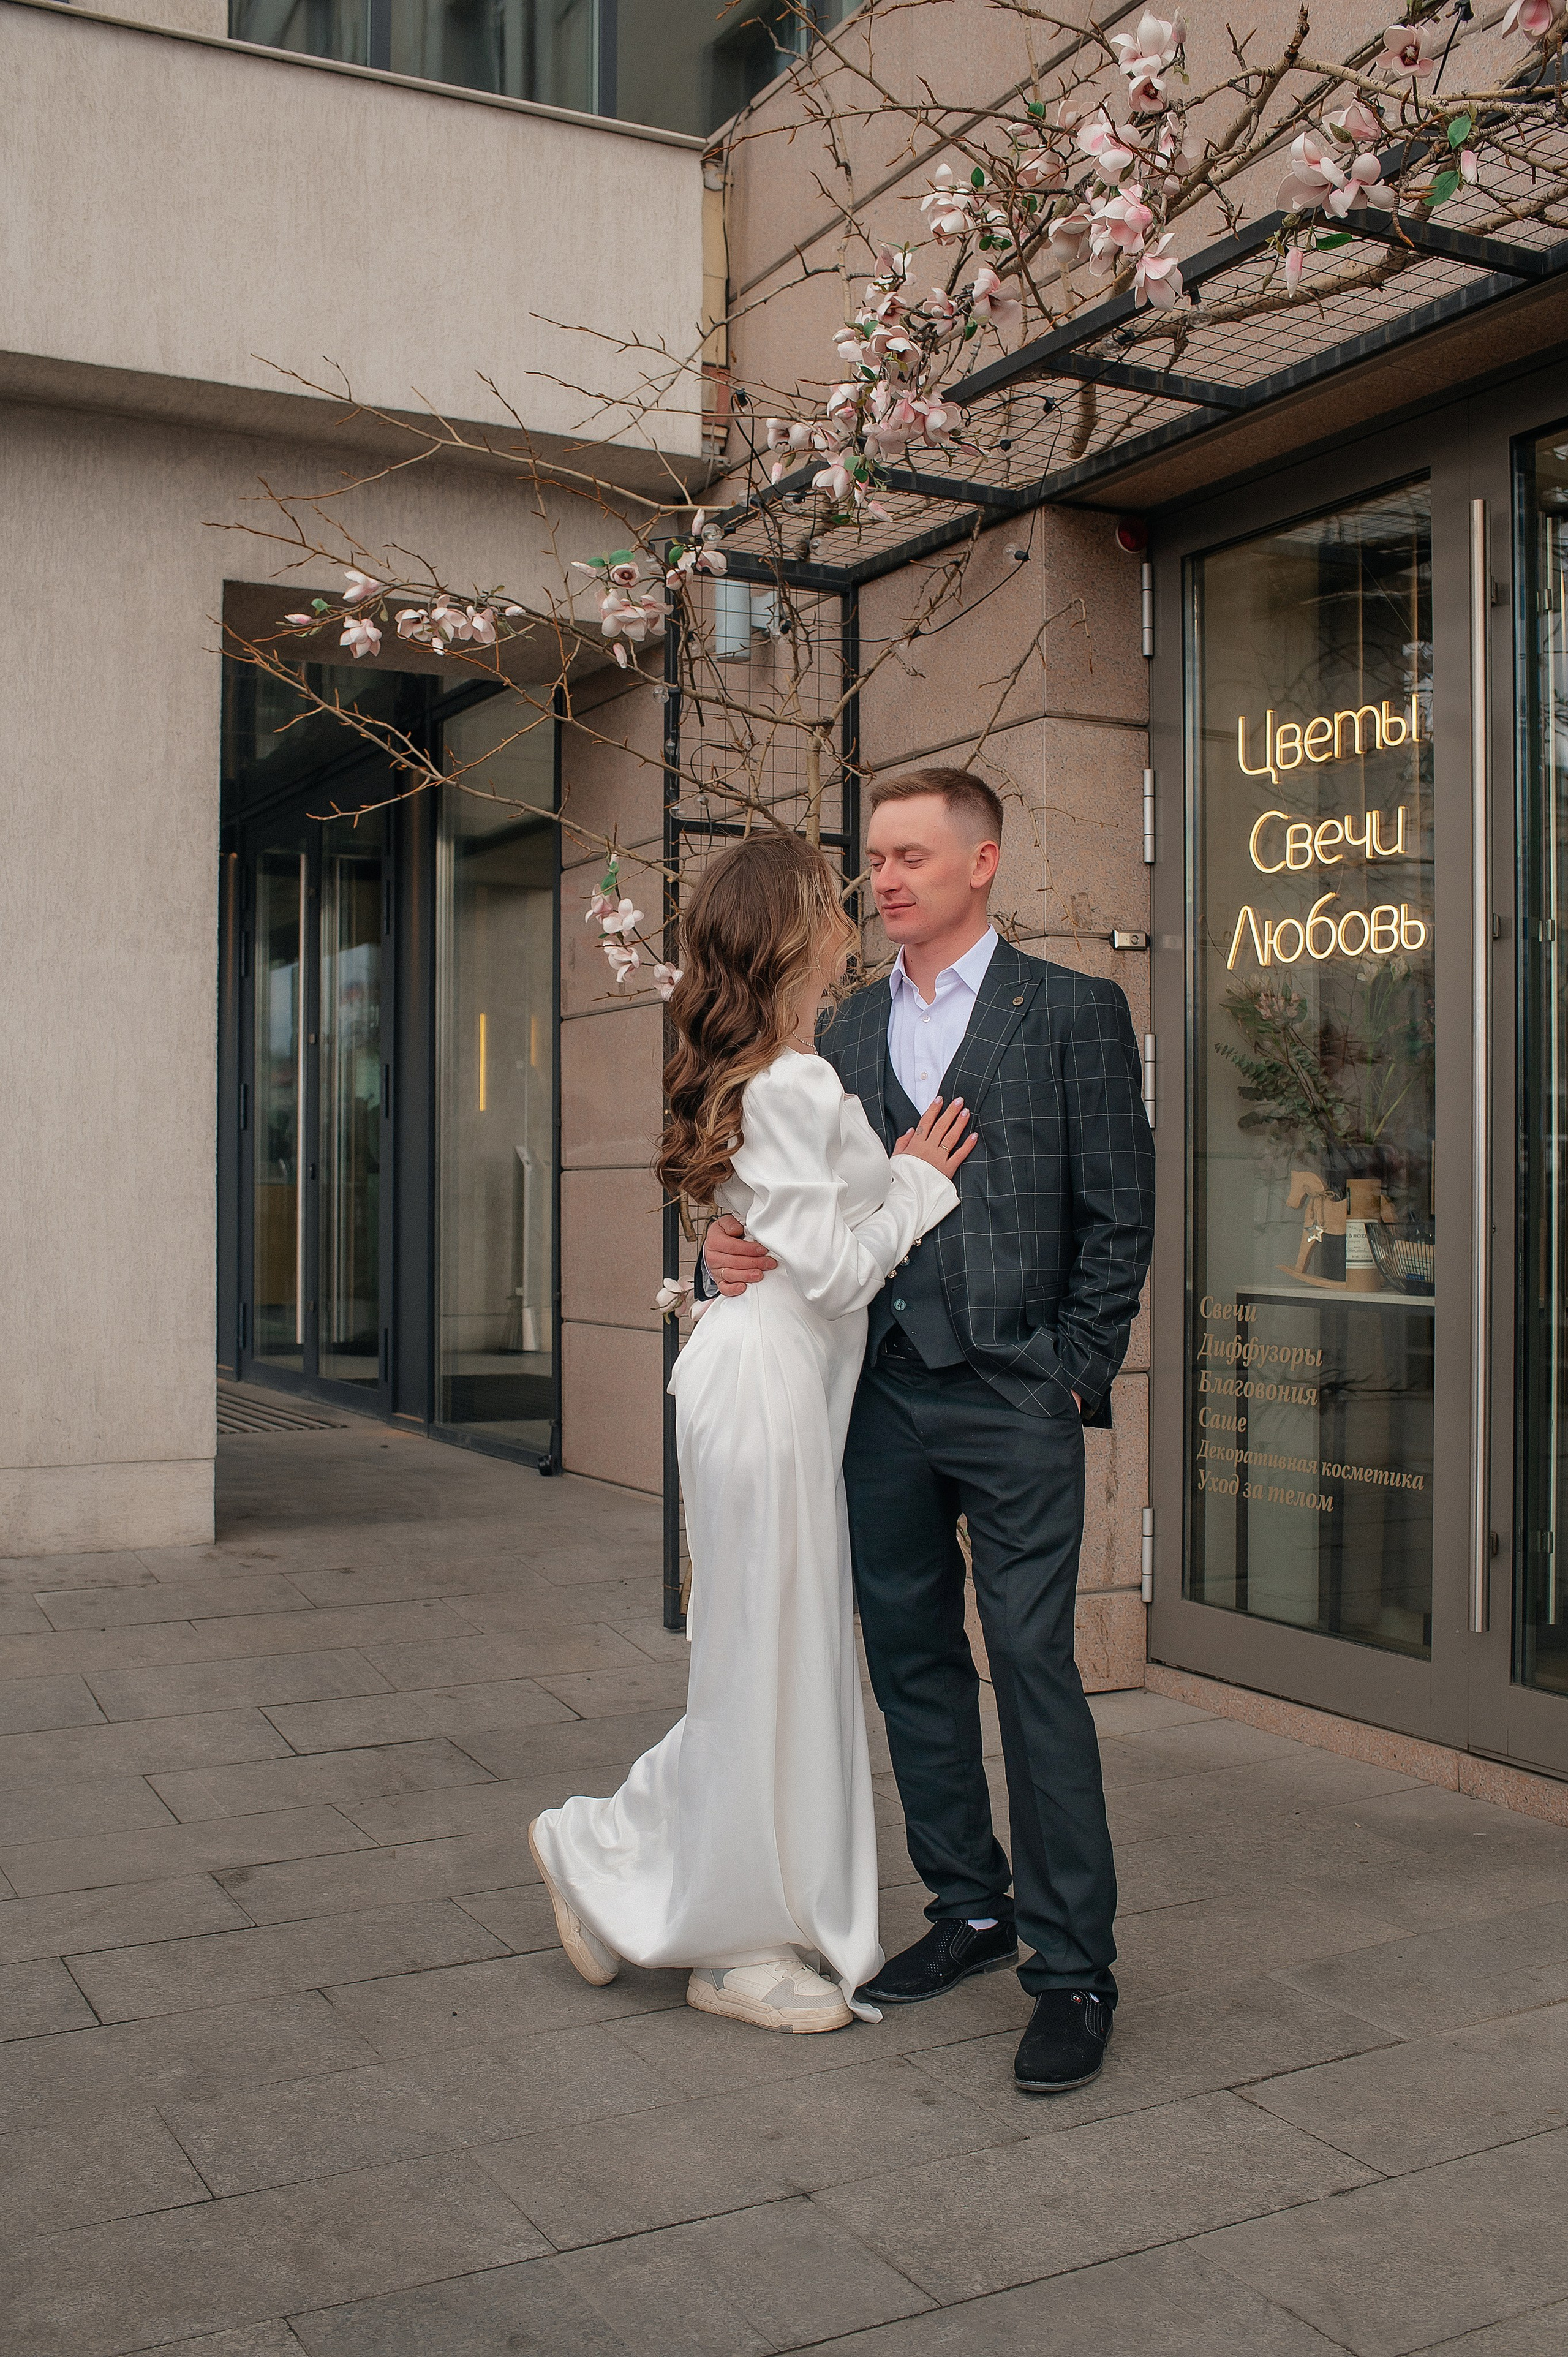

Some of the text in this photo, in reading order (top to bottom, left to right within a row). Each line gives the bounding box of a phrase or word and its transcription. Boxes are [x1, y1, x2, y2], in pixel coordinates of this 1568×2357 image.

[1238, 694, 1420, 785] Цветы
[1250, 806, 1407, 873] Свечи
[1227, 892, 1427, 970] Любовь
[1200, 1295, 1257, 1322] Свечи
[1197, 1333, 1323, 1371] Диффузоры
[1198, 1370, 1317, 1406] Благовония
[1199, 1406, 1247, 1433] Саше
[1196, 1439, 1424, 1490] Декоративная косметика
[1197, 1469, 1333, 1512] Уход за телом
